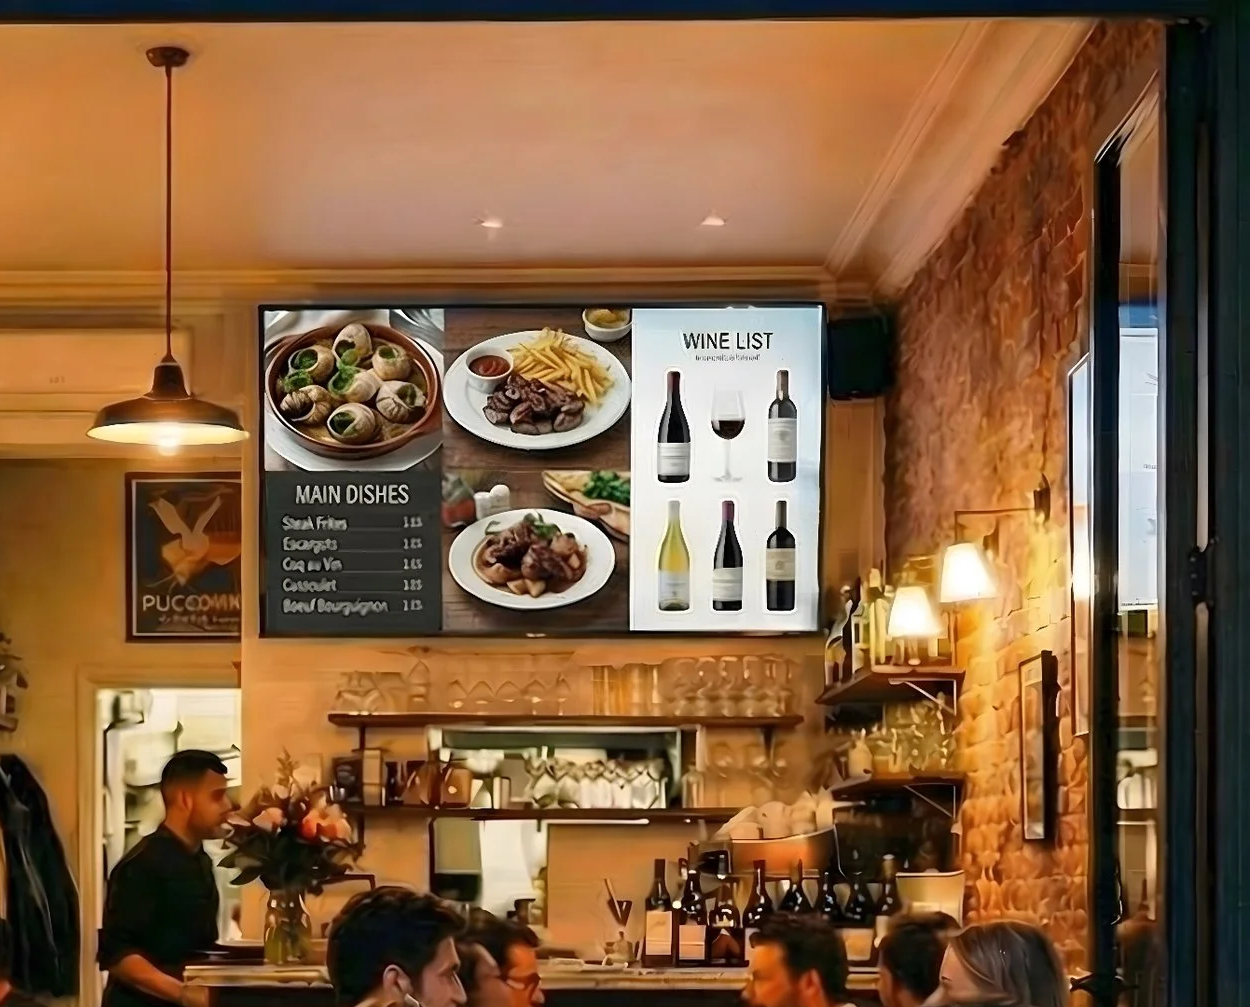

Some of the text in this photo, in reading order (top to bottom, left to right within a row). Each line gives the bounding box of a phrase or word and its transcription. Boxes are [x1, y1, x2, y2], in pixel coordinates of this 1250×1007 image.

[683, 332, 773, 350] WINE LIST
[295, 484, 410, 504] MAIN DISHES
